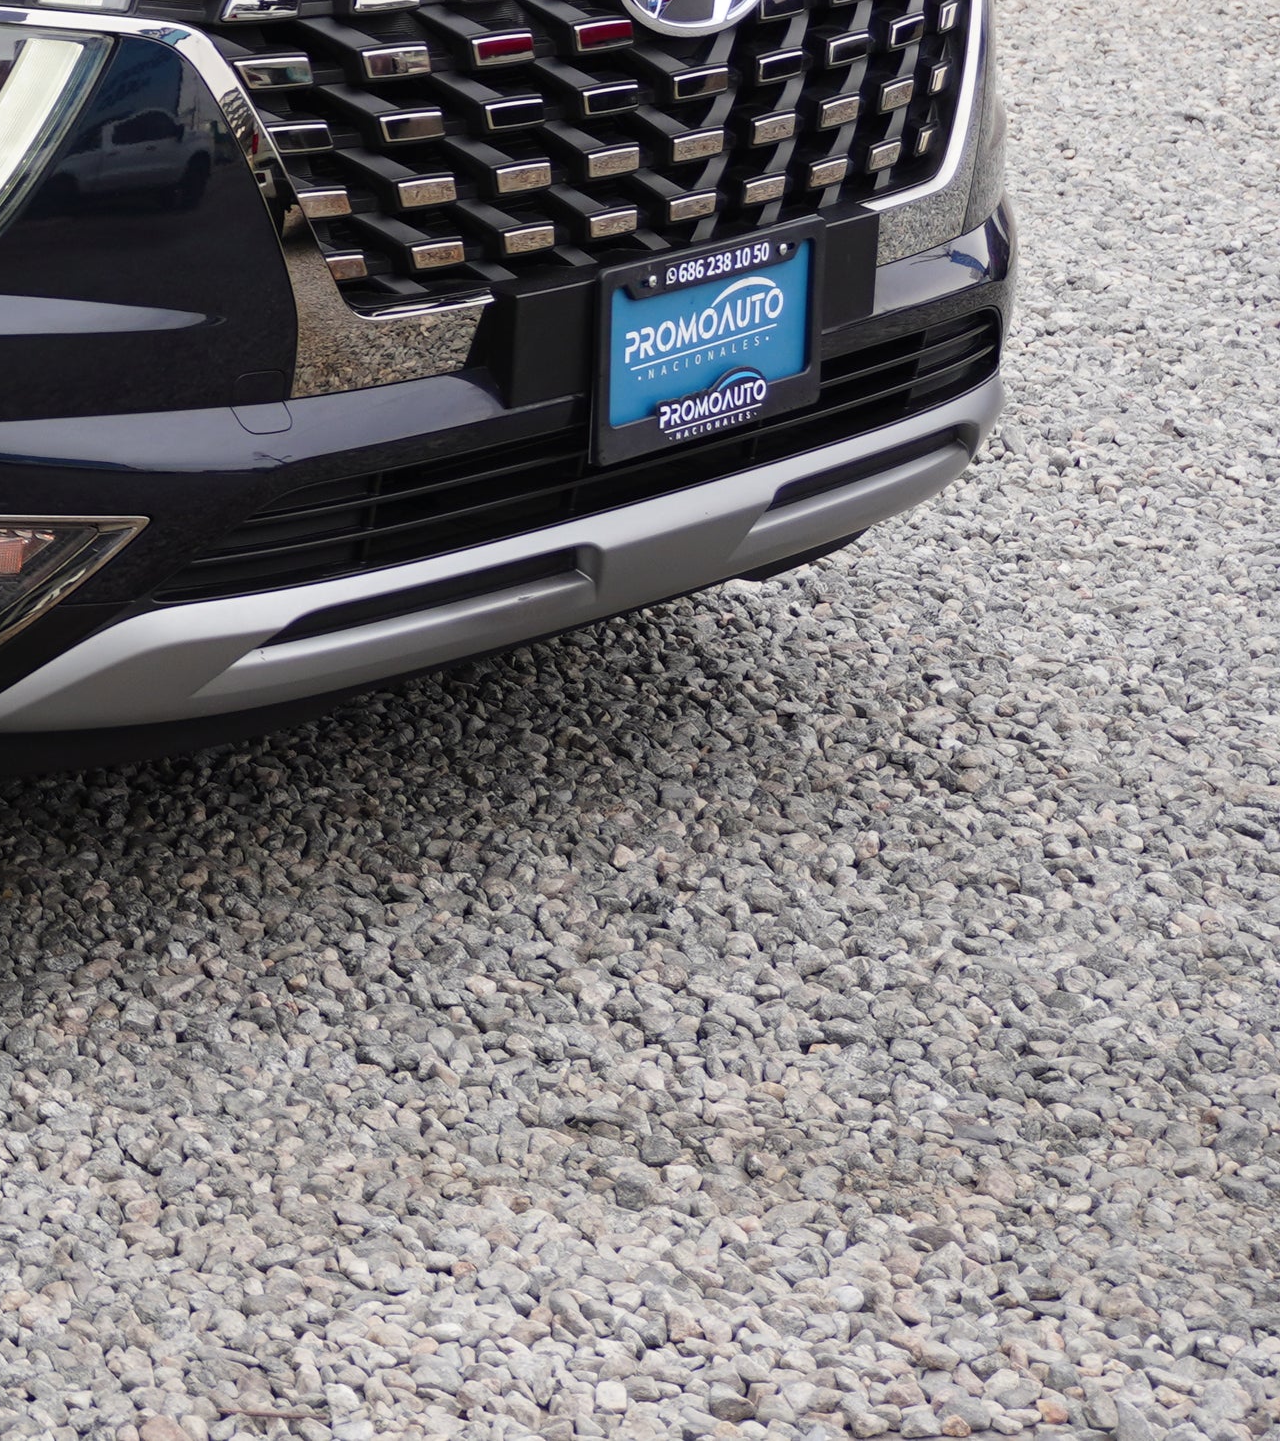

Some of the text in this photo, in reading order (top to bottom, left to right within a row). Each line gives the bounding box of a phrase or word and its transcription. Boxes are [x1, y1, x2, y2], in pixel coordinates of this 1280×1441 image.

[678, 241, 770, 283] 686 238 10 50
[624, 287, 784, 364] PROMOAUTO
[647, 335, 761, 380] NACIONALES
[659, 377, 767, 429] PROMOAUTO
[675, 410, 752, 440] NACIONALES
